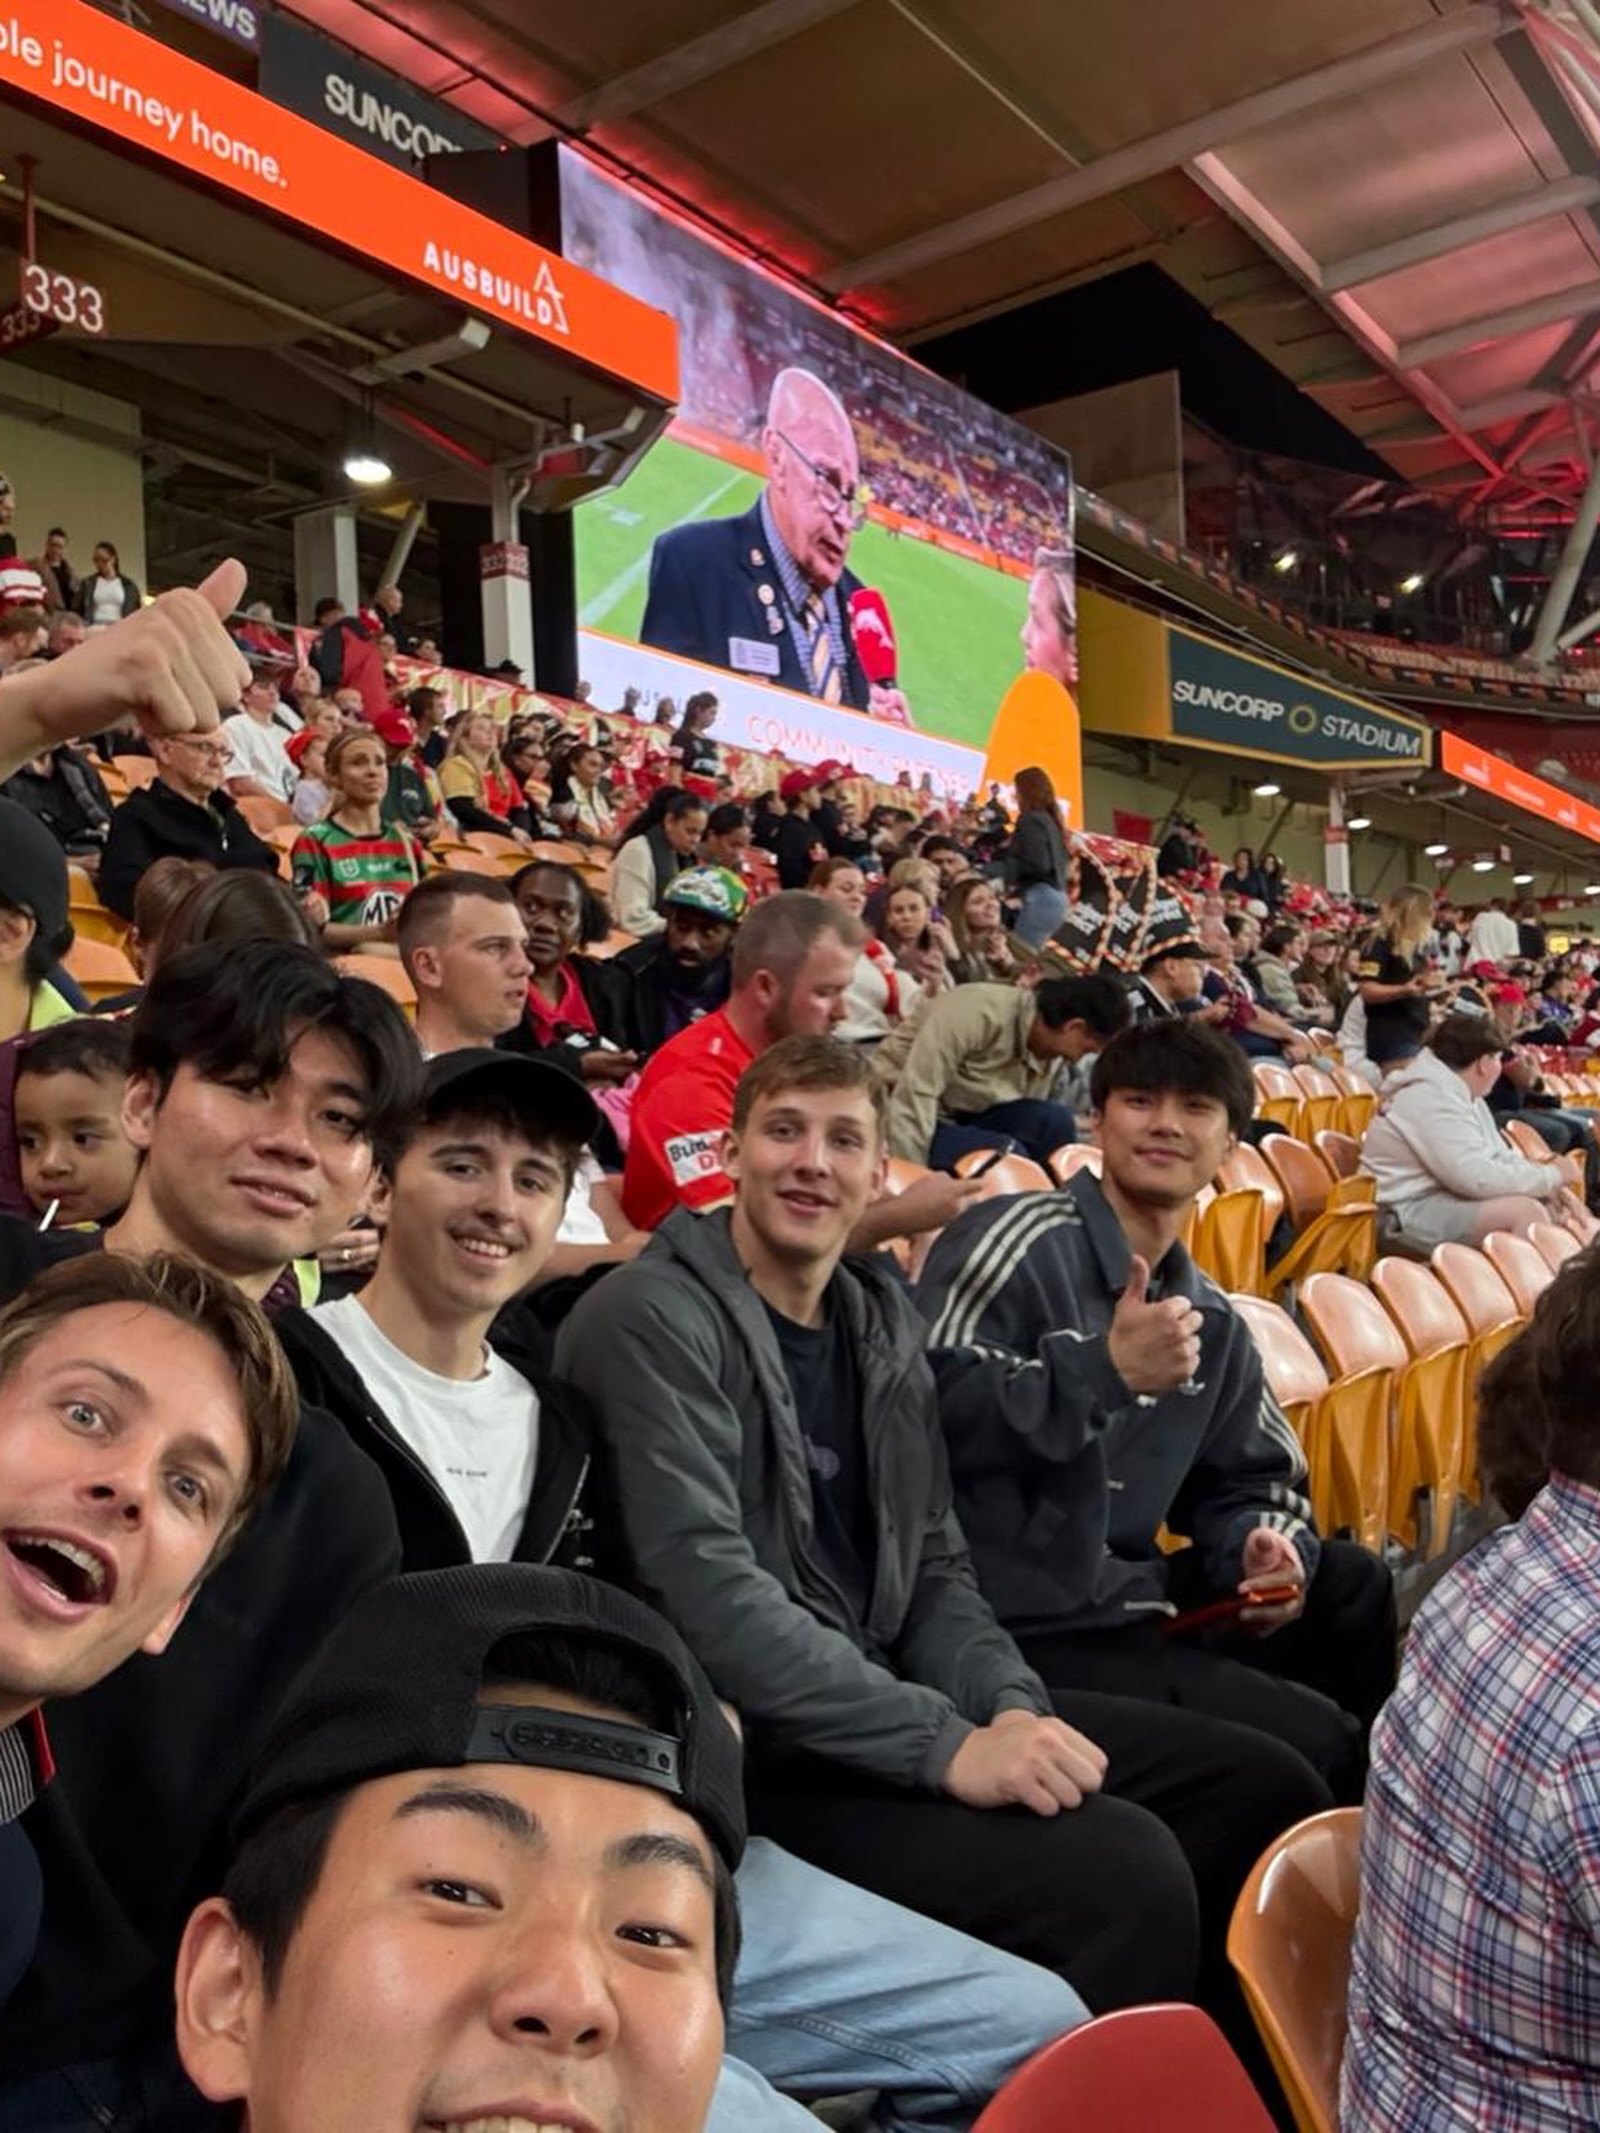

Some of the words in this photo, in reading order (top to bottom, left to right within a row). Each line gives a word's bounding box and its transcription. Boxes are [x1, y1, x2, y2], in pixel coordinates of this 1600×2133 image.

[182, 0, 257, 40] EWS
[52, 38, 184, 141] journey
[190, 109, 288, 189] home.
[324, 73, 464, 160] SUNCO
[25, 264, 104, 334] 333
[422, 241, 553, 326] AUSBUILD
[1172, 679, 1285, 723] SUNCORP
[1320, 714, 1422, 757] STADIUM
